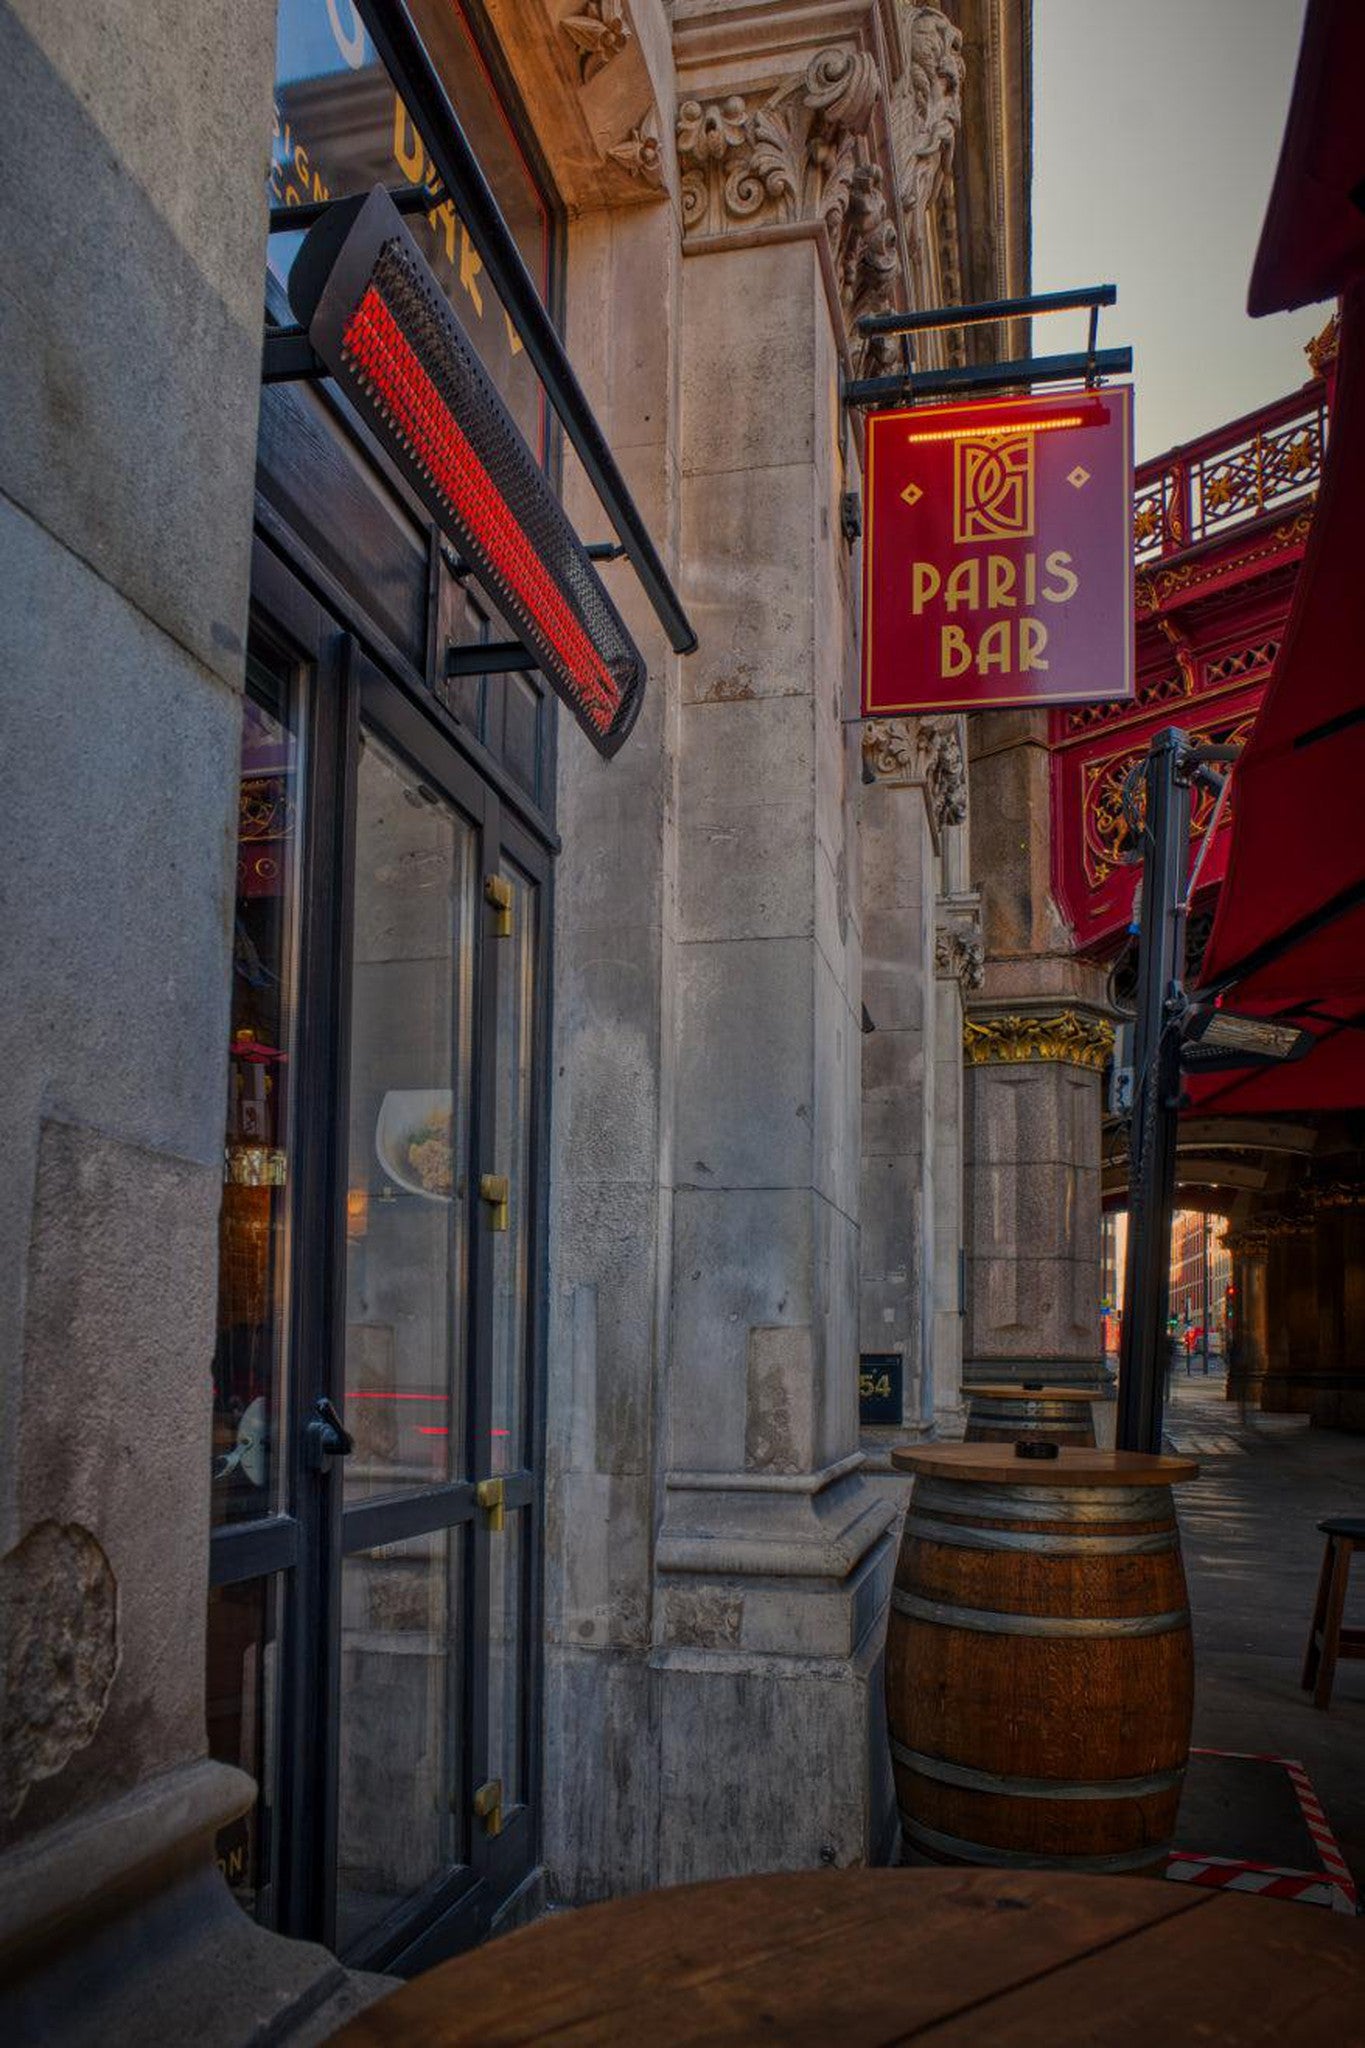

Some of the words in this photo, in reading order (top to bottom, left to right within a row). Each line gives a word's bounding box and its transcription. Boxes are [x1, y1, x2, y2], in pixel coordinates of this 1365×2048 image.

[911, 550, 1079, 615] PARIS
[939, 617, 1050, 678] BAR
[859, 1372, 892, 1398] 54
